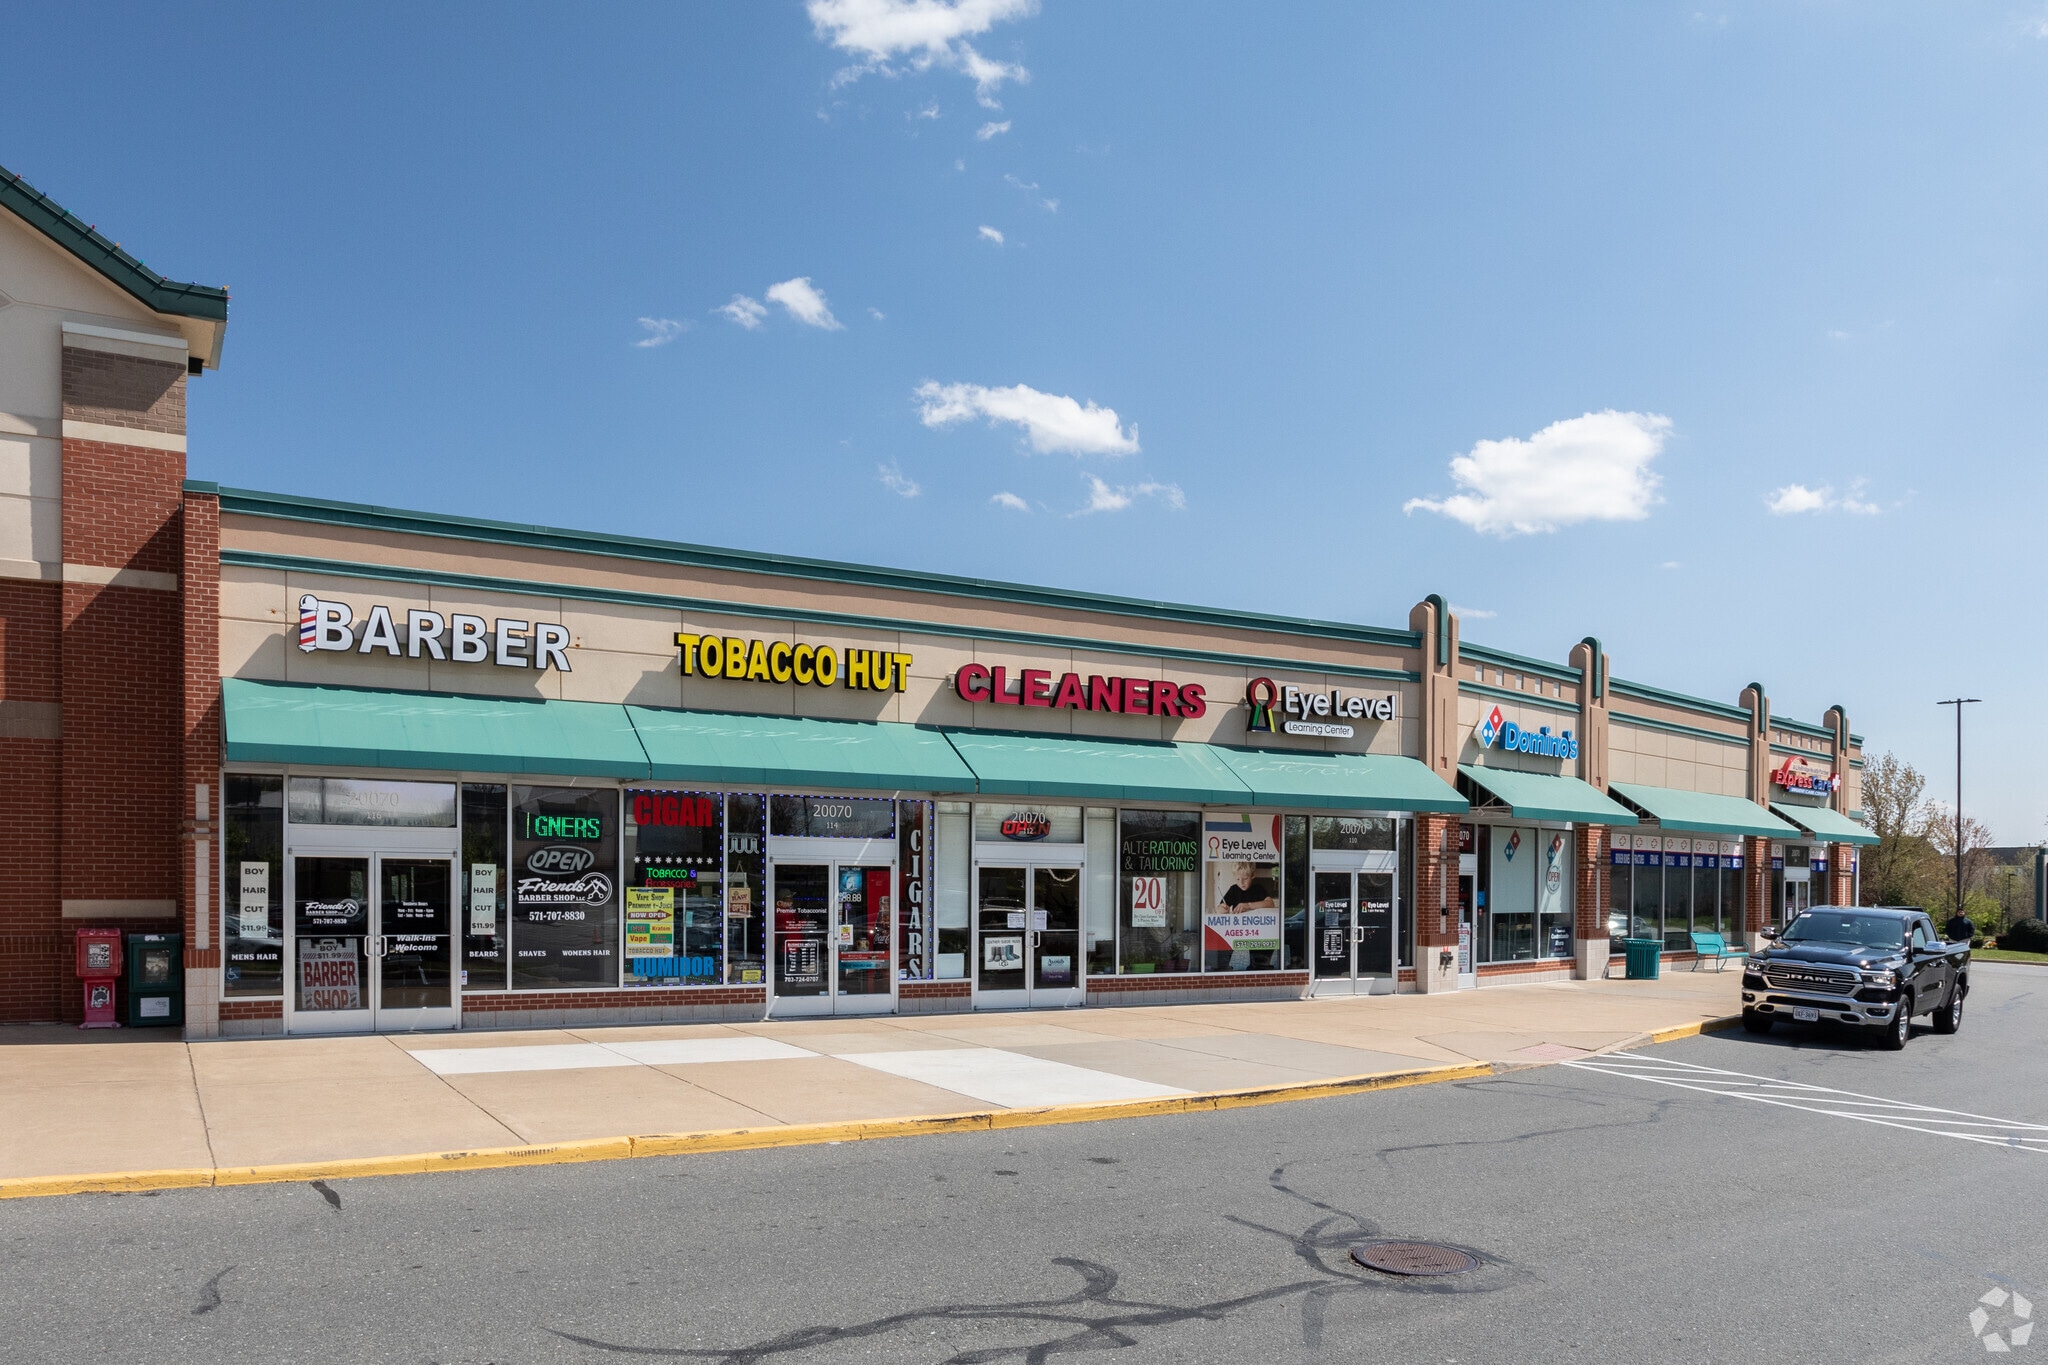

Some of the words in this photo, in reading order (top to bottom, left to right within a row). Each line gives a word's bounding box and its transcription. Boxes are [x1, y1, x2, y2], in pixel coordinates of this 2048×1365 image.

[315, 599, 572, 672] BARBER
[675, 632, 838, 687] TOBACCO
[845, 648, 912, 693] HUT
[955, 663, 1206, 719] CLEANERS
[1283, 685, 1330, 720] Eye
[1333, 690, 1396, 721] Level
[1288, 721, 1323, 735] Learning
[1325, 723, 1350, 736] Center
[1503, 721, 1579, 760] Domino's
[1773, 768, 1832, 791] ExpressCare
[633, 795, 713, 827] CIGAR
[813, 804, 852, 818] 20070
[1011, 811, 1046, 824] 20070
[1002, 819, 1051, 835] OPEN
[1023, 827, 1034, 835] 112
[1340, 823, 1367, 834] 20070
[1459, 831, 1470, 841] 070
[1122, 840, 1197, 855] ALTERATIONS
[1222, 839, 1240, 851] Eye
[1242, 839, 1267, 850] Level
[531, 849, 588, 871] OPEN
[1222, 851, 1252, 861] Learning
[1253, 852, 1276, 860] Center
[1125, 857, 1134, 871] &
[1139, 856, 1195, 871] TAILORING
[689, 869, 697, 878] &
[1548, 871, 1560, 882] OPEN
[517, 877, 586, 894] Friends
[645, 878, 697, 888] Accessories
[242, 886, 267, 894] HAIR
[244, 905, 264, 913] CUT
[305, 902, 343, 911] Friends
[732, 904, 748, 912] OPEN
[908, 829, 922, 979] CIGARS
[528, 911, 585, 921] 571-707-8830
[1207, 916, 1231, 926] MATH
[1233, 916, 1240, 926] &
[1241, 916, 1276, 926] ENGLISH
[240, 924, 267, 932] $11.99
[1224, 929, 1243, 937] AGES
[630, 935, 648, 943] Vape
[395, 943, 438, 951] Welcome
[633, 956, 714, 978] HUMIDOR
[303, 961, 357, 987] BARBER
[1790, 974, 1828, 982] RAM
[313, 989, 349, 1008] SHOP
